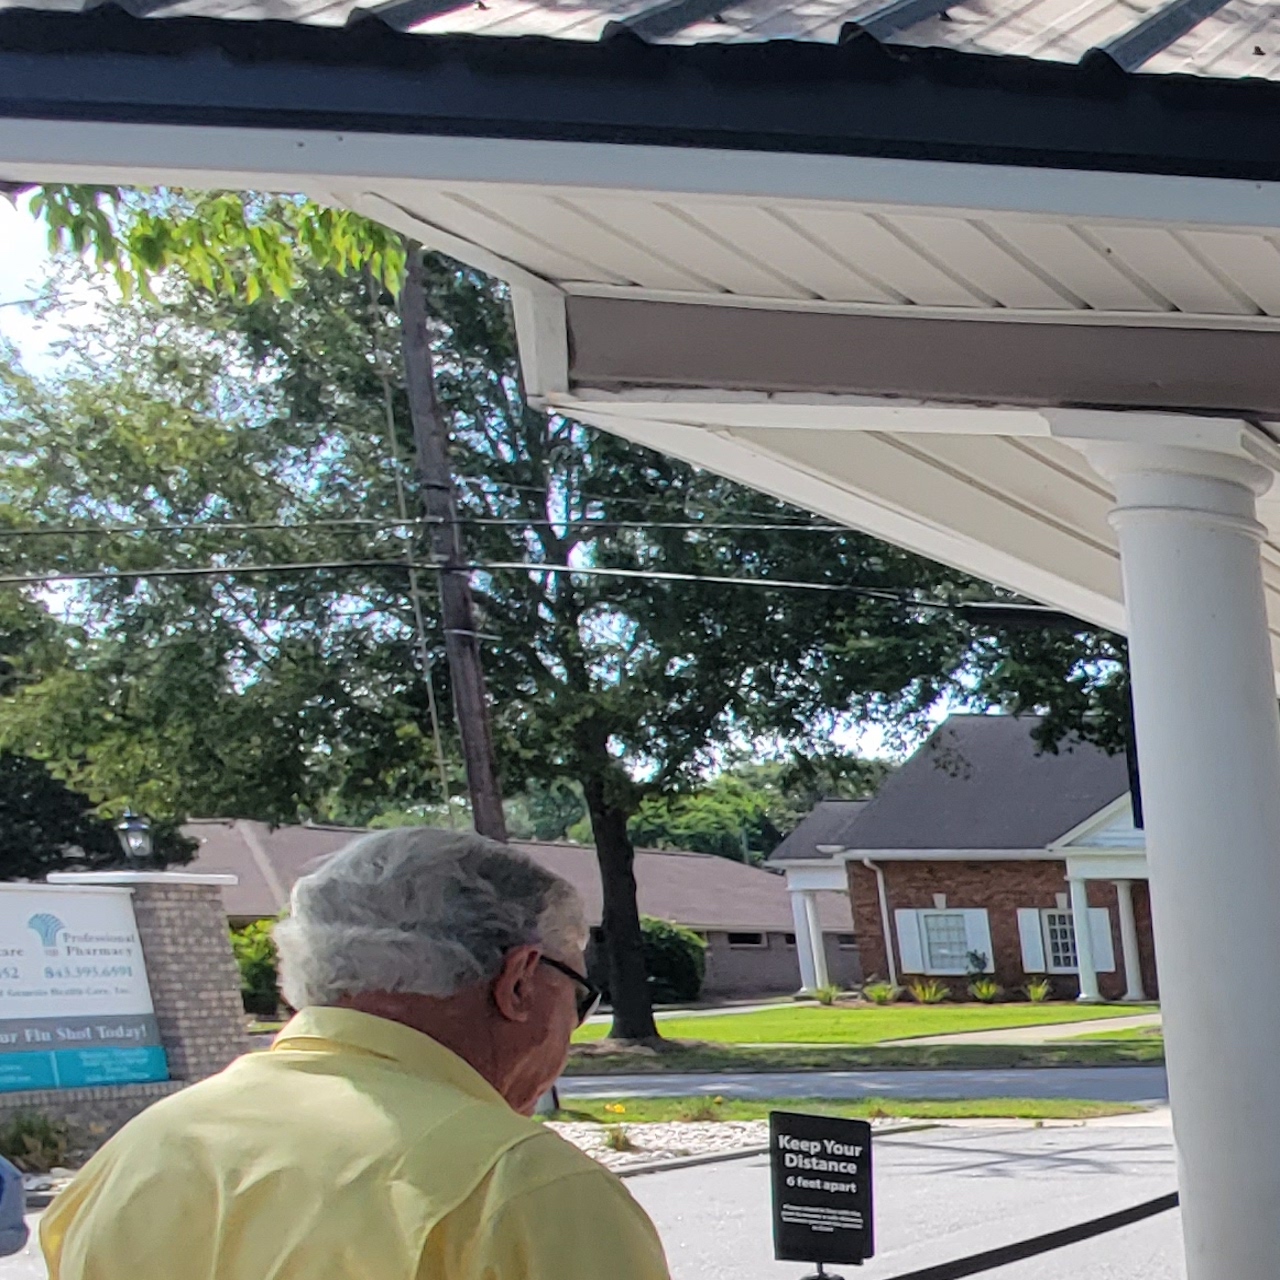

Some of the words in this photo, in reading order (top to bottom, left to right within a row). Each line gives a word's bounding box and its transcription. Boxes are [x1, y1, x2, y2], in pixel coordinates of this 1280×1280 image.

[62, 932, 135, 943] Professional
[66, 946, 133, 957] Pharmacy
[24, 1028, 52, 1043] Flu
[56, 1026, 92, 1040] Shot
[95, 1024, 147, 1041] Today!
[778, 1134, 821, 1156] Keep
[823, 1139, 863, 1157] Your
[784, 1153, 858, 1174] Distance
[786, 1176, 795, 1187] 6
[797, 1177, 821, 1190] feet
[823, 1180, 857, 1193] apart
